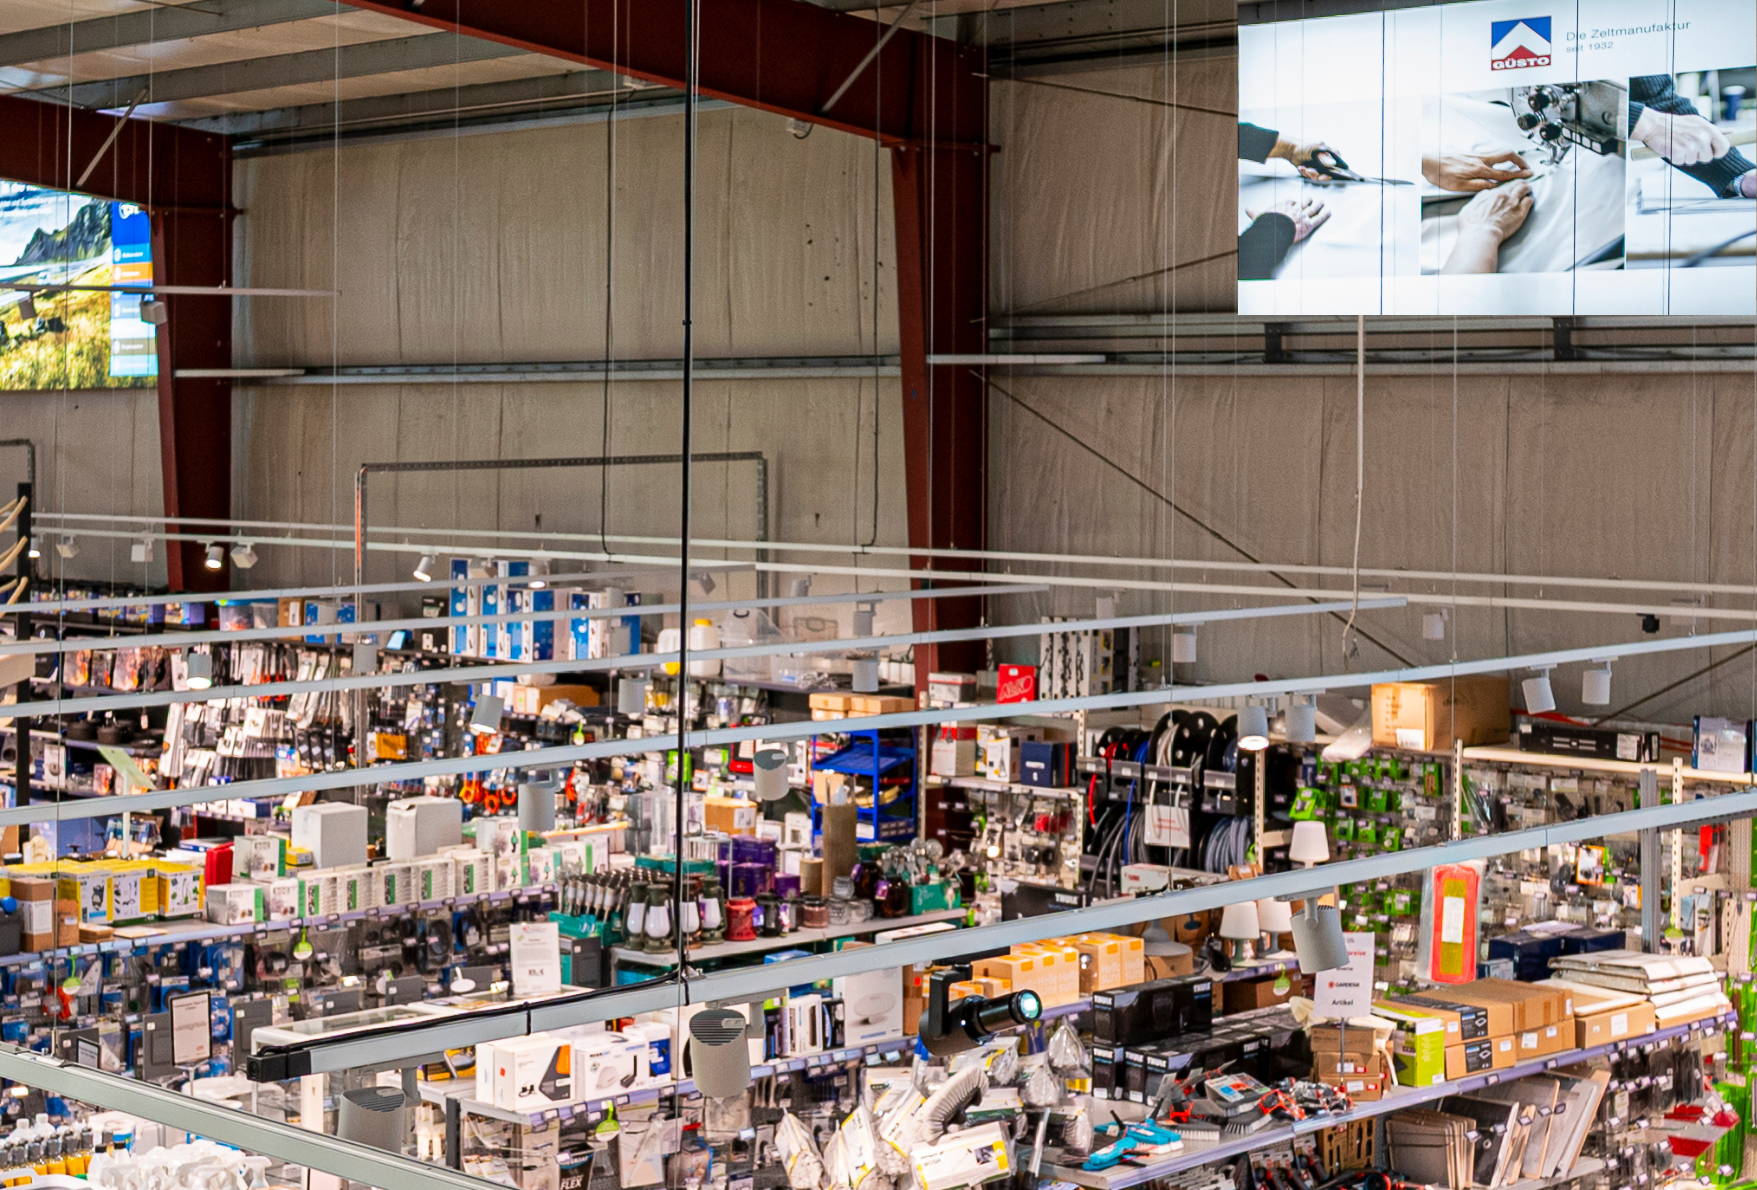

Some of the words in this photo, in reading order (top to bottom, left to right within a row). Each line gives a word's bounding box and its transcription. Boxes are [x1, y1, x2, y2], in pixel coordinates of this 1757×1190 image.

[1590, 21, 1692, 39] Zeltmanufaktur
[1588, 41, 1613, 51] 1932
[1492, 56, 1550, 70] GÜSTO
[559, 1178, 583, 1190] FLEX
